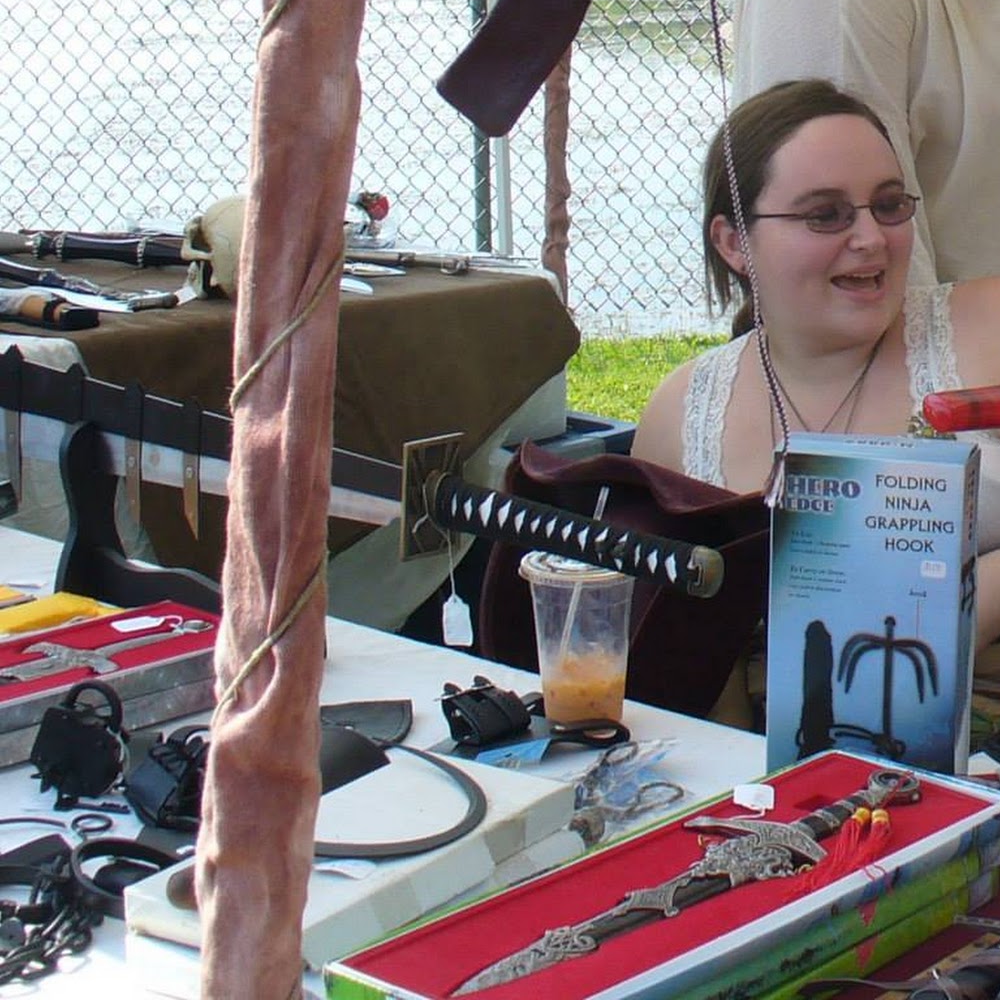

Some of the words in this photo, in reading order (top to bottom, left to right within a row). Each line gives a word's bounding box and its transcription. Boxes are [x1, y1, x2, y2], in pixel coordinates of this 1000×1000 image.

[786, 477, 861, 499] HERO
[875, 474, 947, 492] FOLDING
[885, 496, 932, 512] NINJA
[864, 515, 955, 534] GRAPPLING
[884, 537, 935, 553] HOOK
